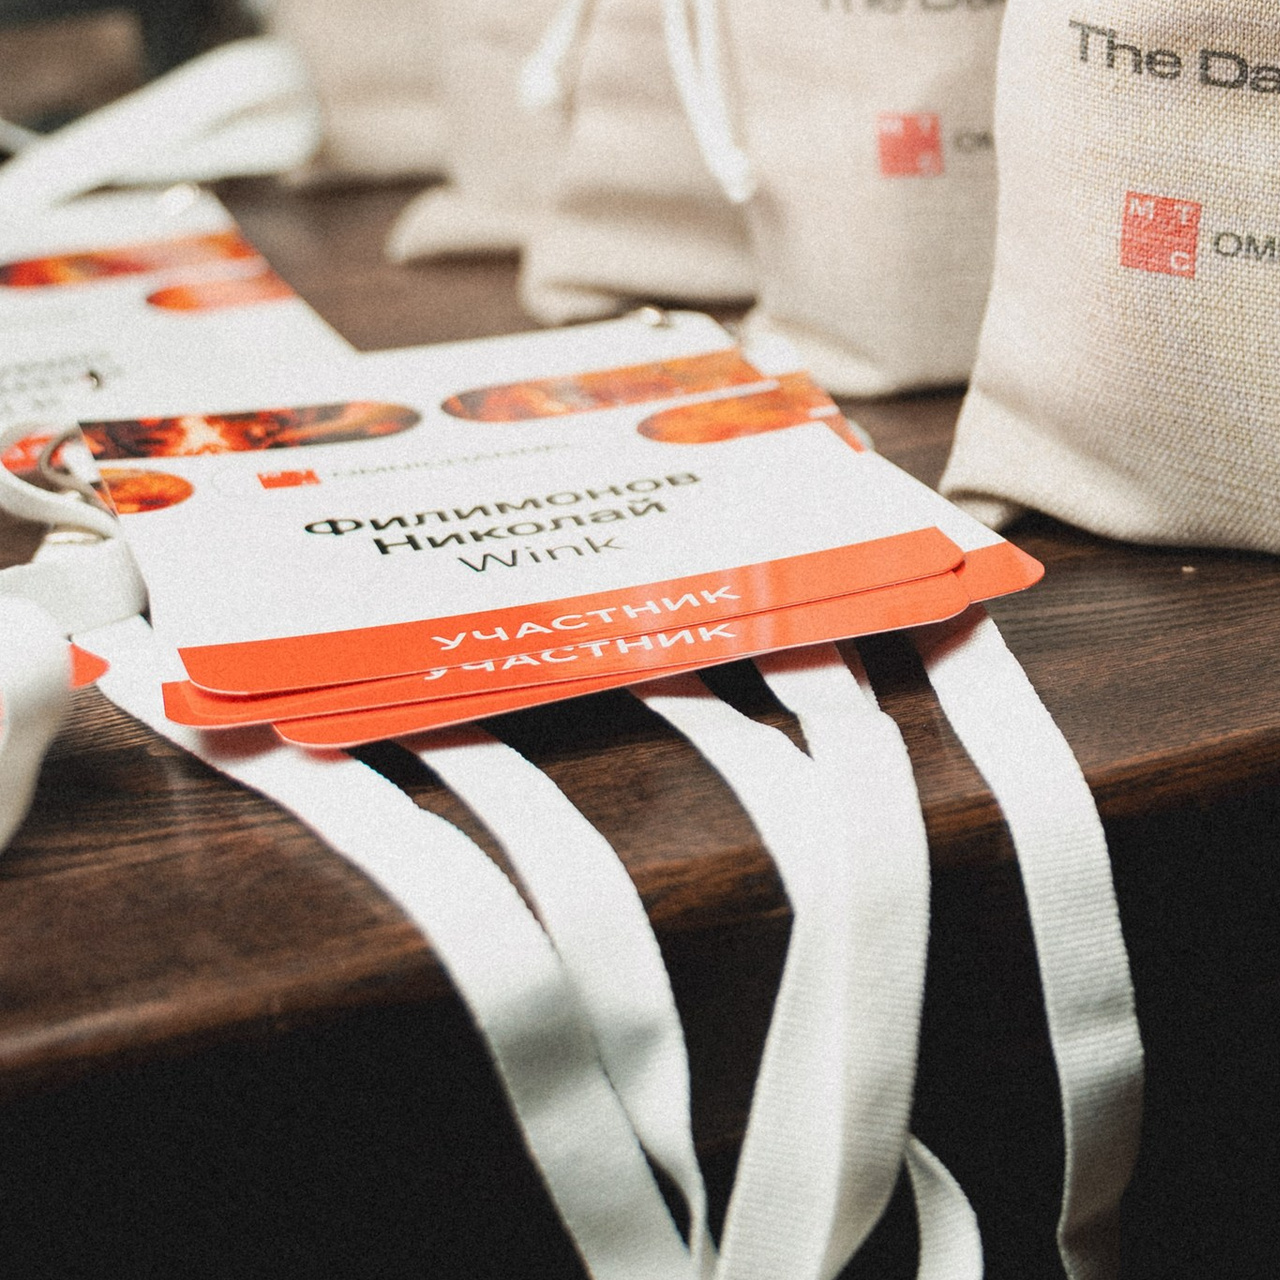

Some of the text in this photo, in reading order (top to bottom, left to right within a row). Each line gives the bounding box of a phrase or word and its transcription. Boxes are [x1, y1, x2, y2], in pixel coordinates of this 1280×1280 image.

[1070, 19, 1183, 81] The
[304, 471, 701, 536] Филимонов
[373, 498, 666, 556] Николай
[457, 536, 625, 573] Wink
[431, 585, 741, 651] УЧАСТНИК
